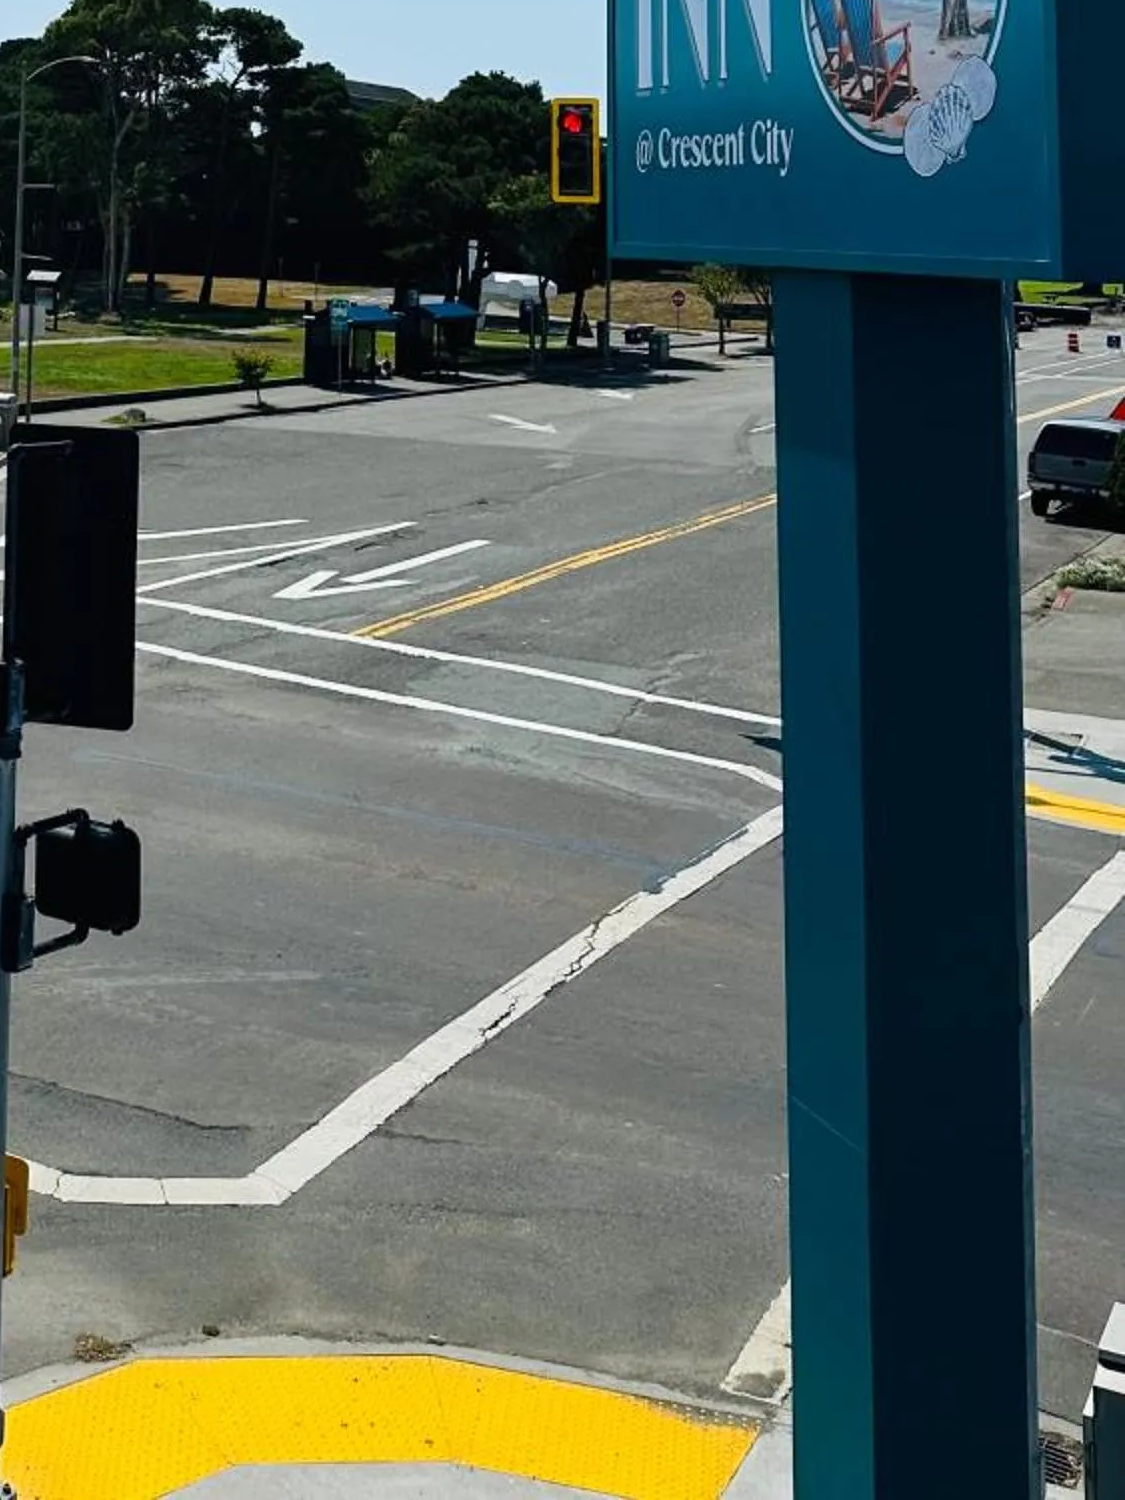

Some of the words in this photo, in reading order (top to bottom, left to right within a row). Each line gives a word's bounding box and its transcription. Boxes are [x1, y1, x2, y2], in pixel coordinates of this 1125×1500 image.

[636, 129, 654, 173] @
[658, 127, 745, 168] Crescent
[750, 118, 794, 177] City
